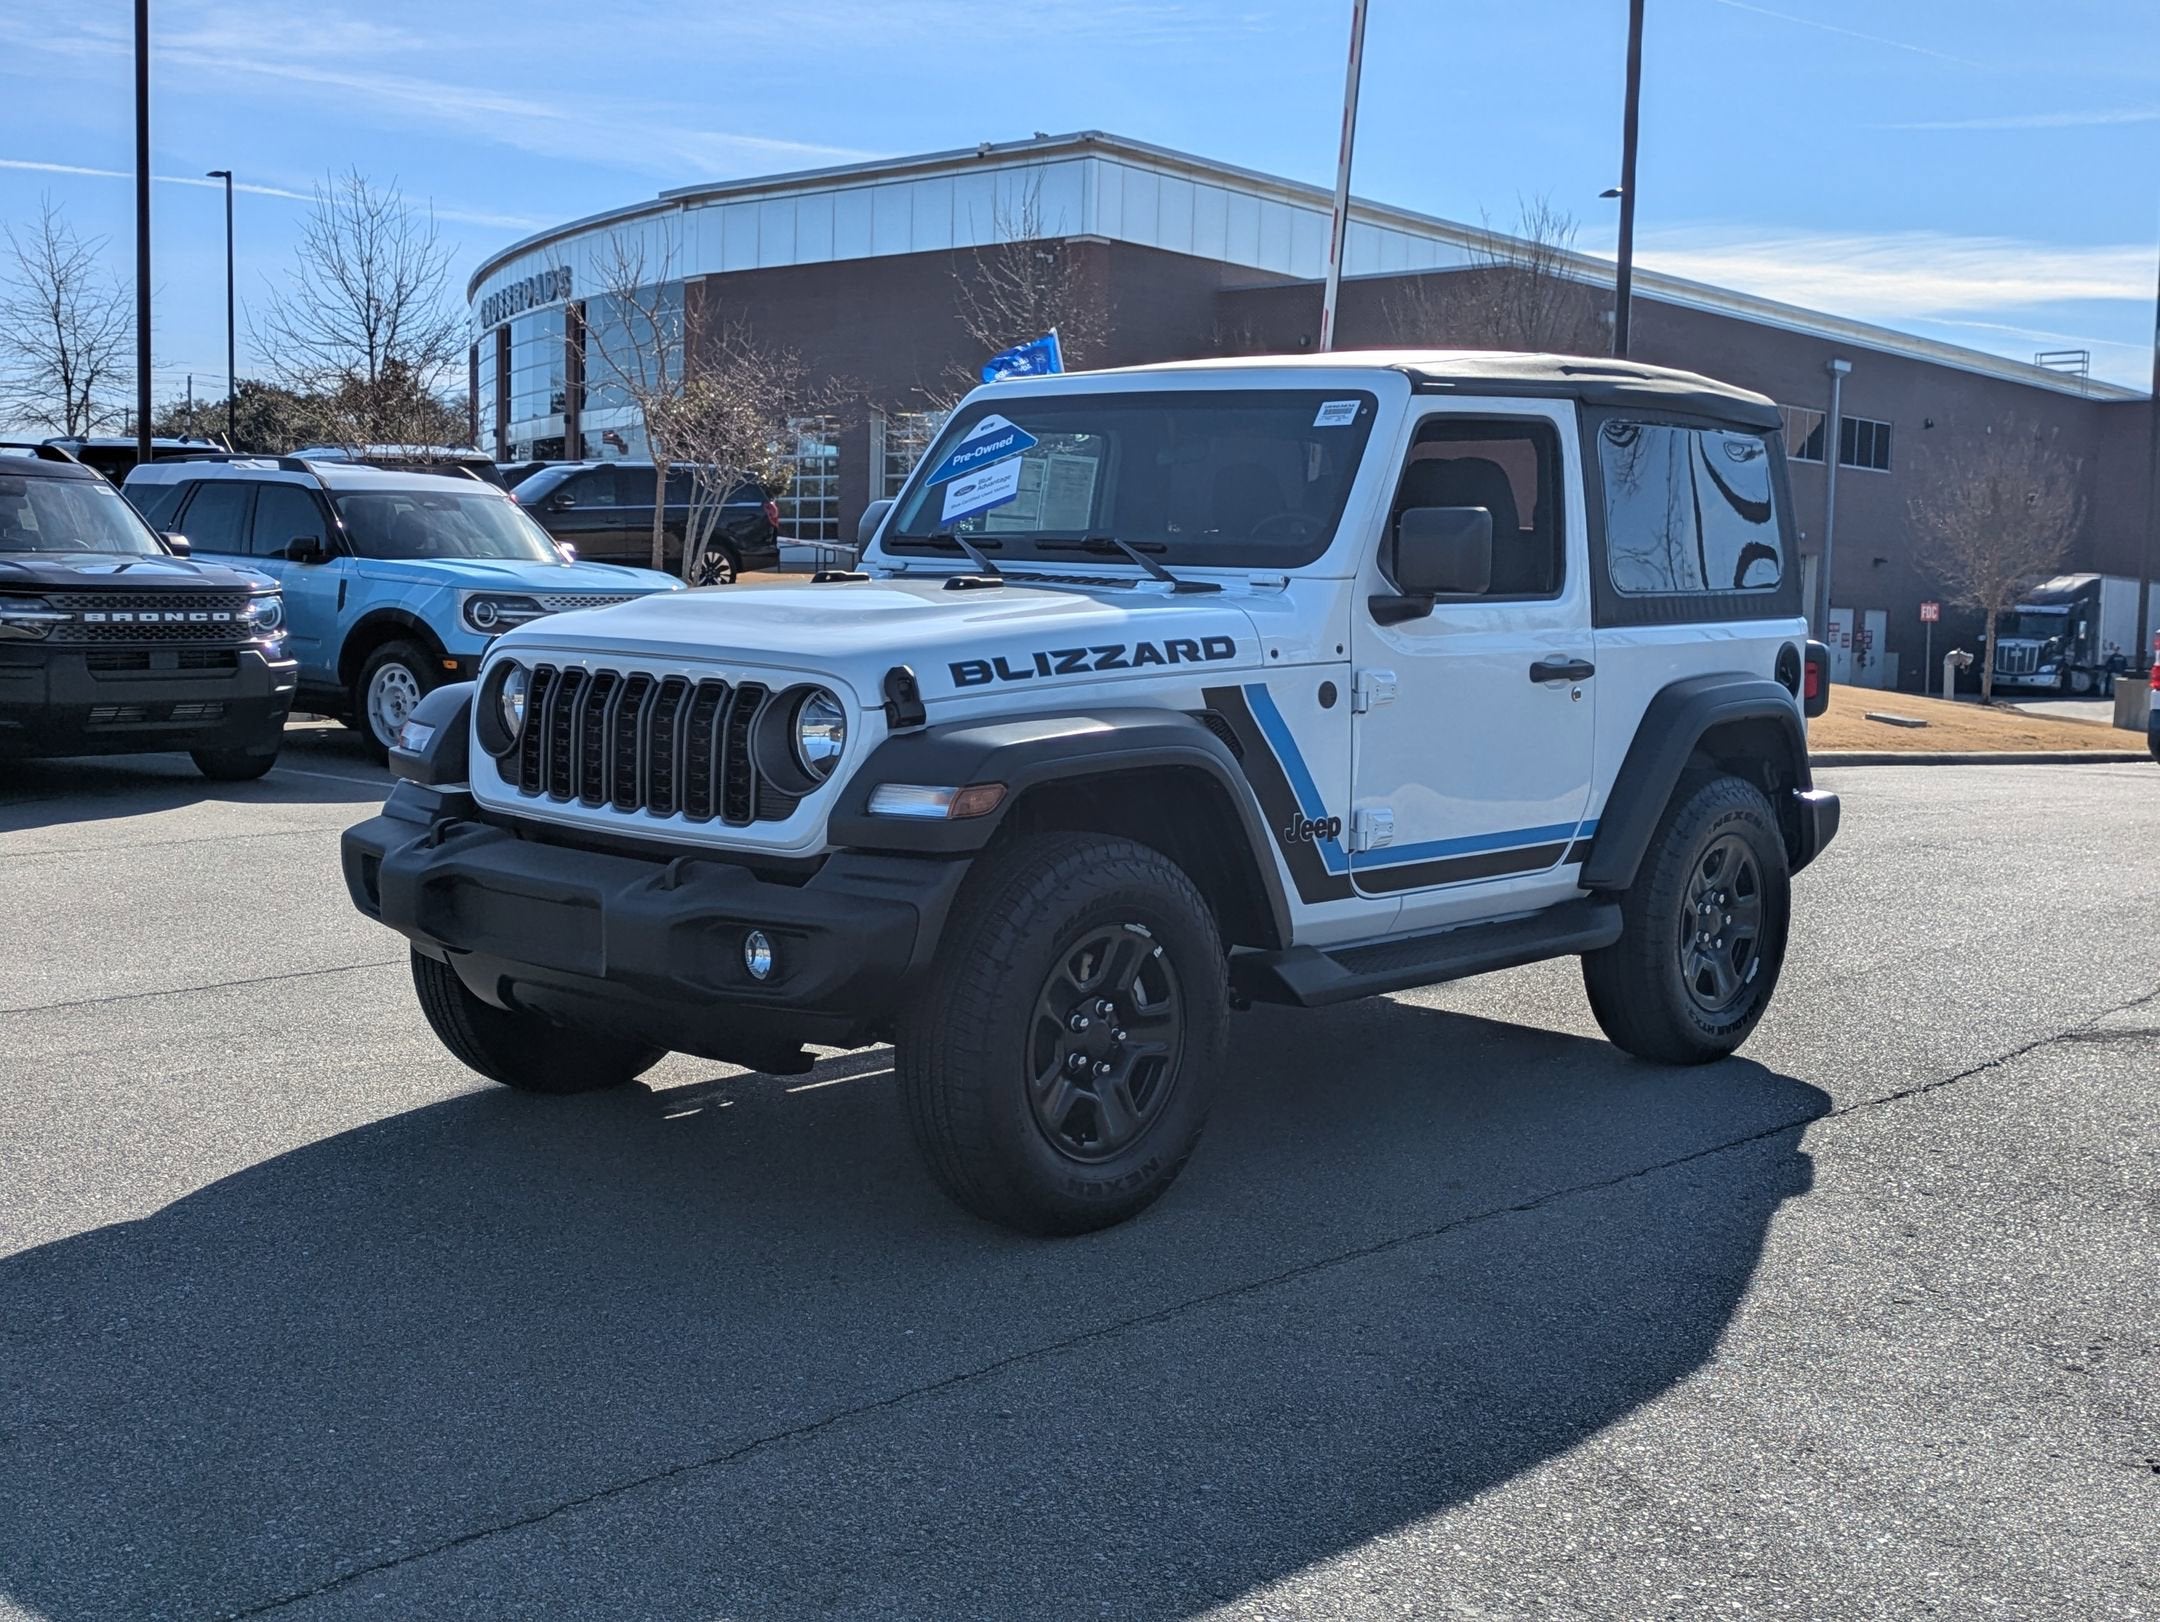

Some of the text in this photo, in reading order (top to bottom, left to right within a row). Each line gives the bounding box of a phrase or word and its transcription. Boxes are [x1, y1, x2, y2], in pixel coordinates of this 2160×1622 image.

[952, 434, 1014, 466] Pre-Owned
[84, 613, 230, 622] BRONCO
[1921, 605, 1938, 619] FDC
[948, 635, 1237, 688] BLIZZARD
[1284, 812, 1342, 844] Jeep
[1713, 811, 1763, 832] NEXEN
